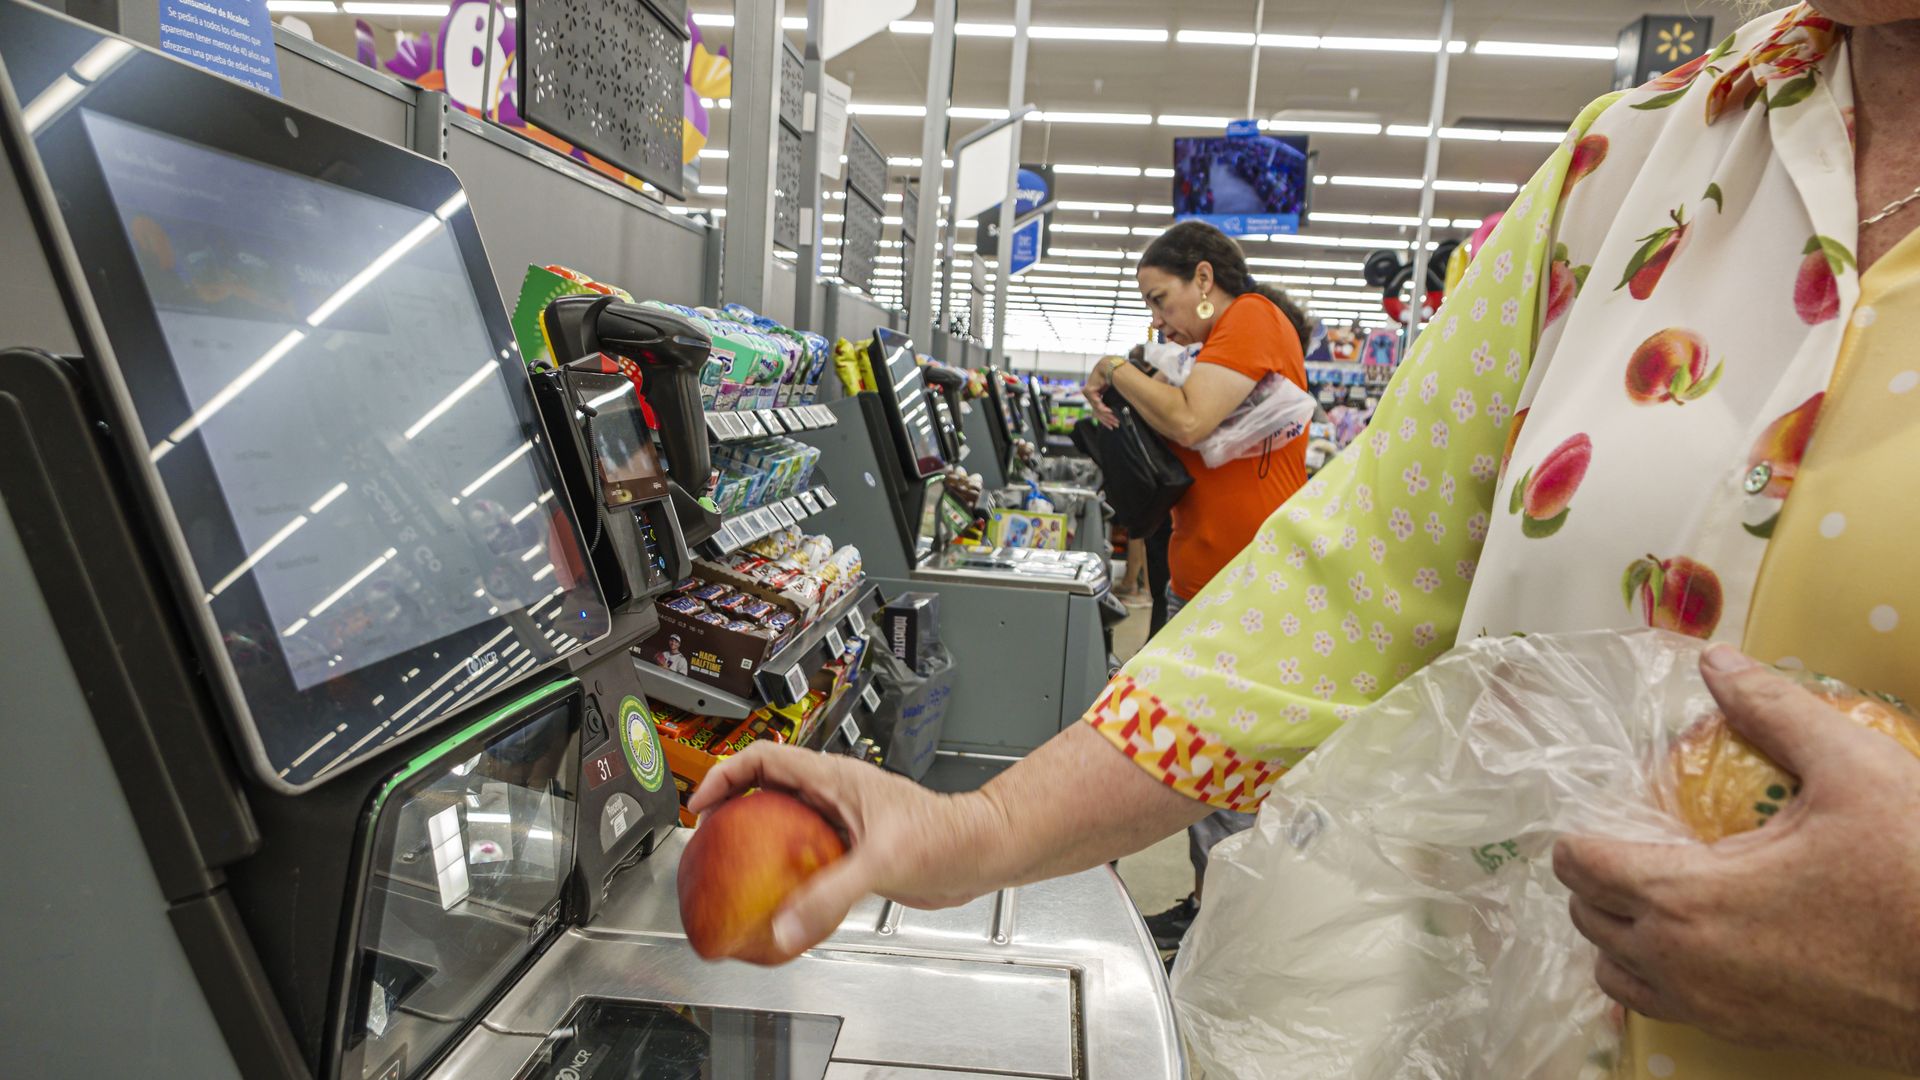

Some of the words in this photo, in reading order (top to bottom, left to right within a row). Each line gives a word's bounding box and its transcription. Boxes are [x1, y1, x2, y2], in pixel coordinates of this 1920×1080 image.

[167, 6, 177, 18] Se
[203, 19, 221, 32] todos
[221, 24, 230, 35] los
[161, 23, 195, 39] aparenten
[195, 32, 212, 44] tener
[212, 38, 232, 51] menos
[232, 43, 240, 54] de
[240, 46, 248, 56] 40
[162, 40, 192, 55] ofrezcan
[191, 49, 205, 59] una
[204, 52, 227, 66] prueba
[226, 58, 234, 68] de
[235, 61, 249, 72] edad
[480, 651, 499, 668] NCR
[597, 757, 612, 780] 31
[569, 1050, 592, 1071] NCR
